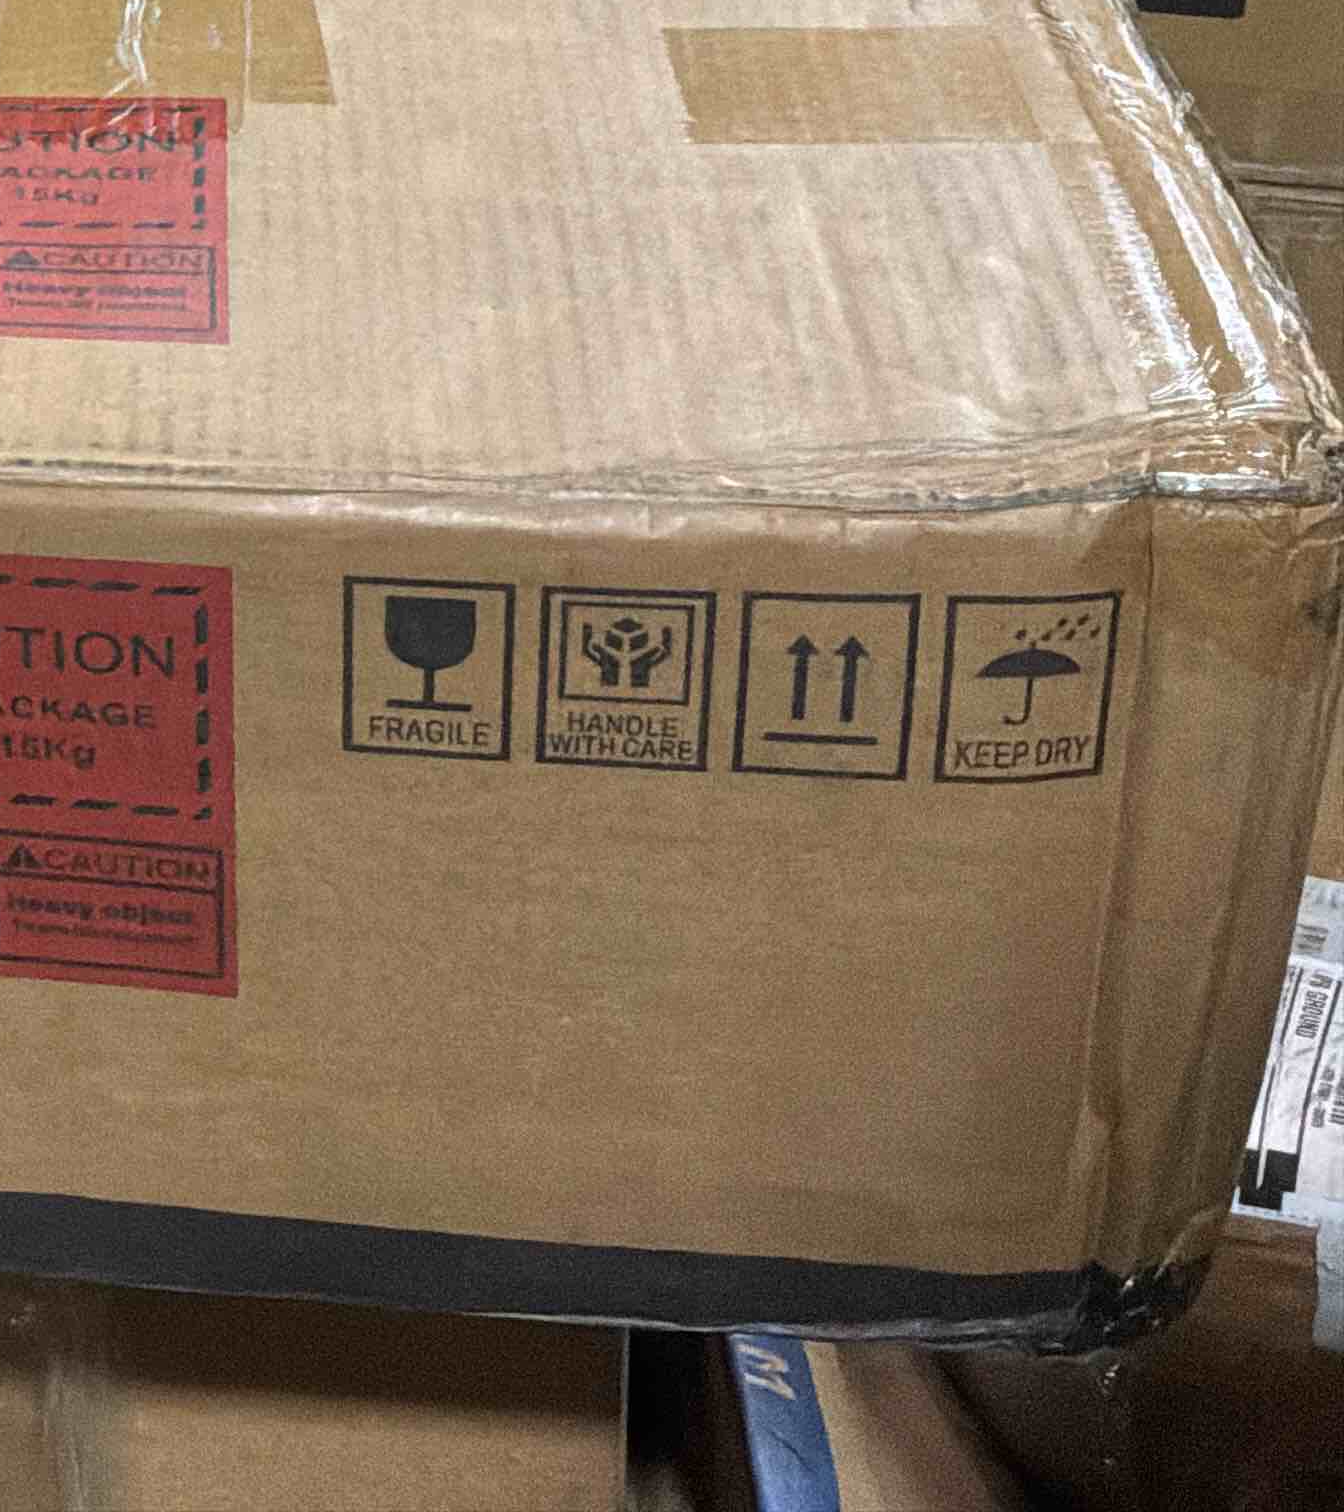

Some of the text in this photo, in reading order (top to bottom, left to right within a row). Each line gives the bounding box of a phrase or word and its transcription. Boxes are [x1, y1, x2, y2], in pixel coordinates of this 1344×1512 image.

[367, 716, 491, 748] FRAGILE
[567, 710, 681, 739] HANDLE
[3, 734, 97, 771] 15Kg
[549, 732, 694, 763] WITH CARE
[954, 737, 1091, 770] KEEP DRY
[43, 845, 211, 882] CAUTION
